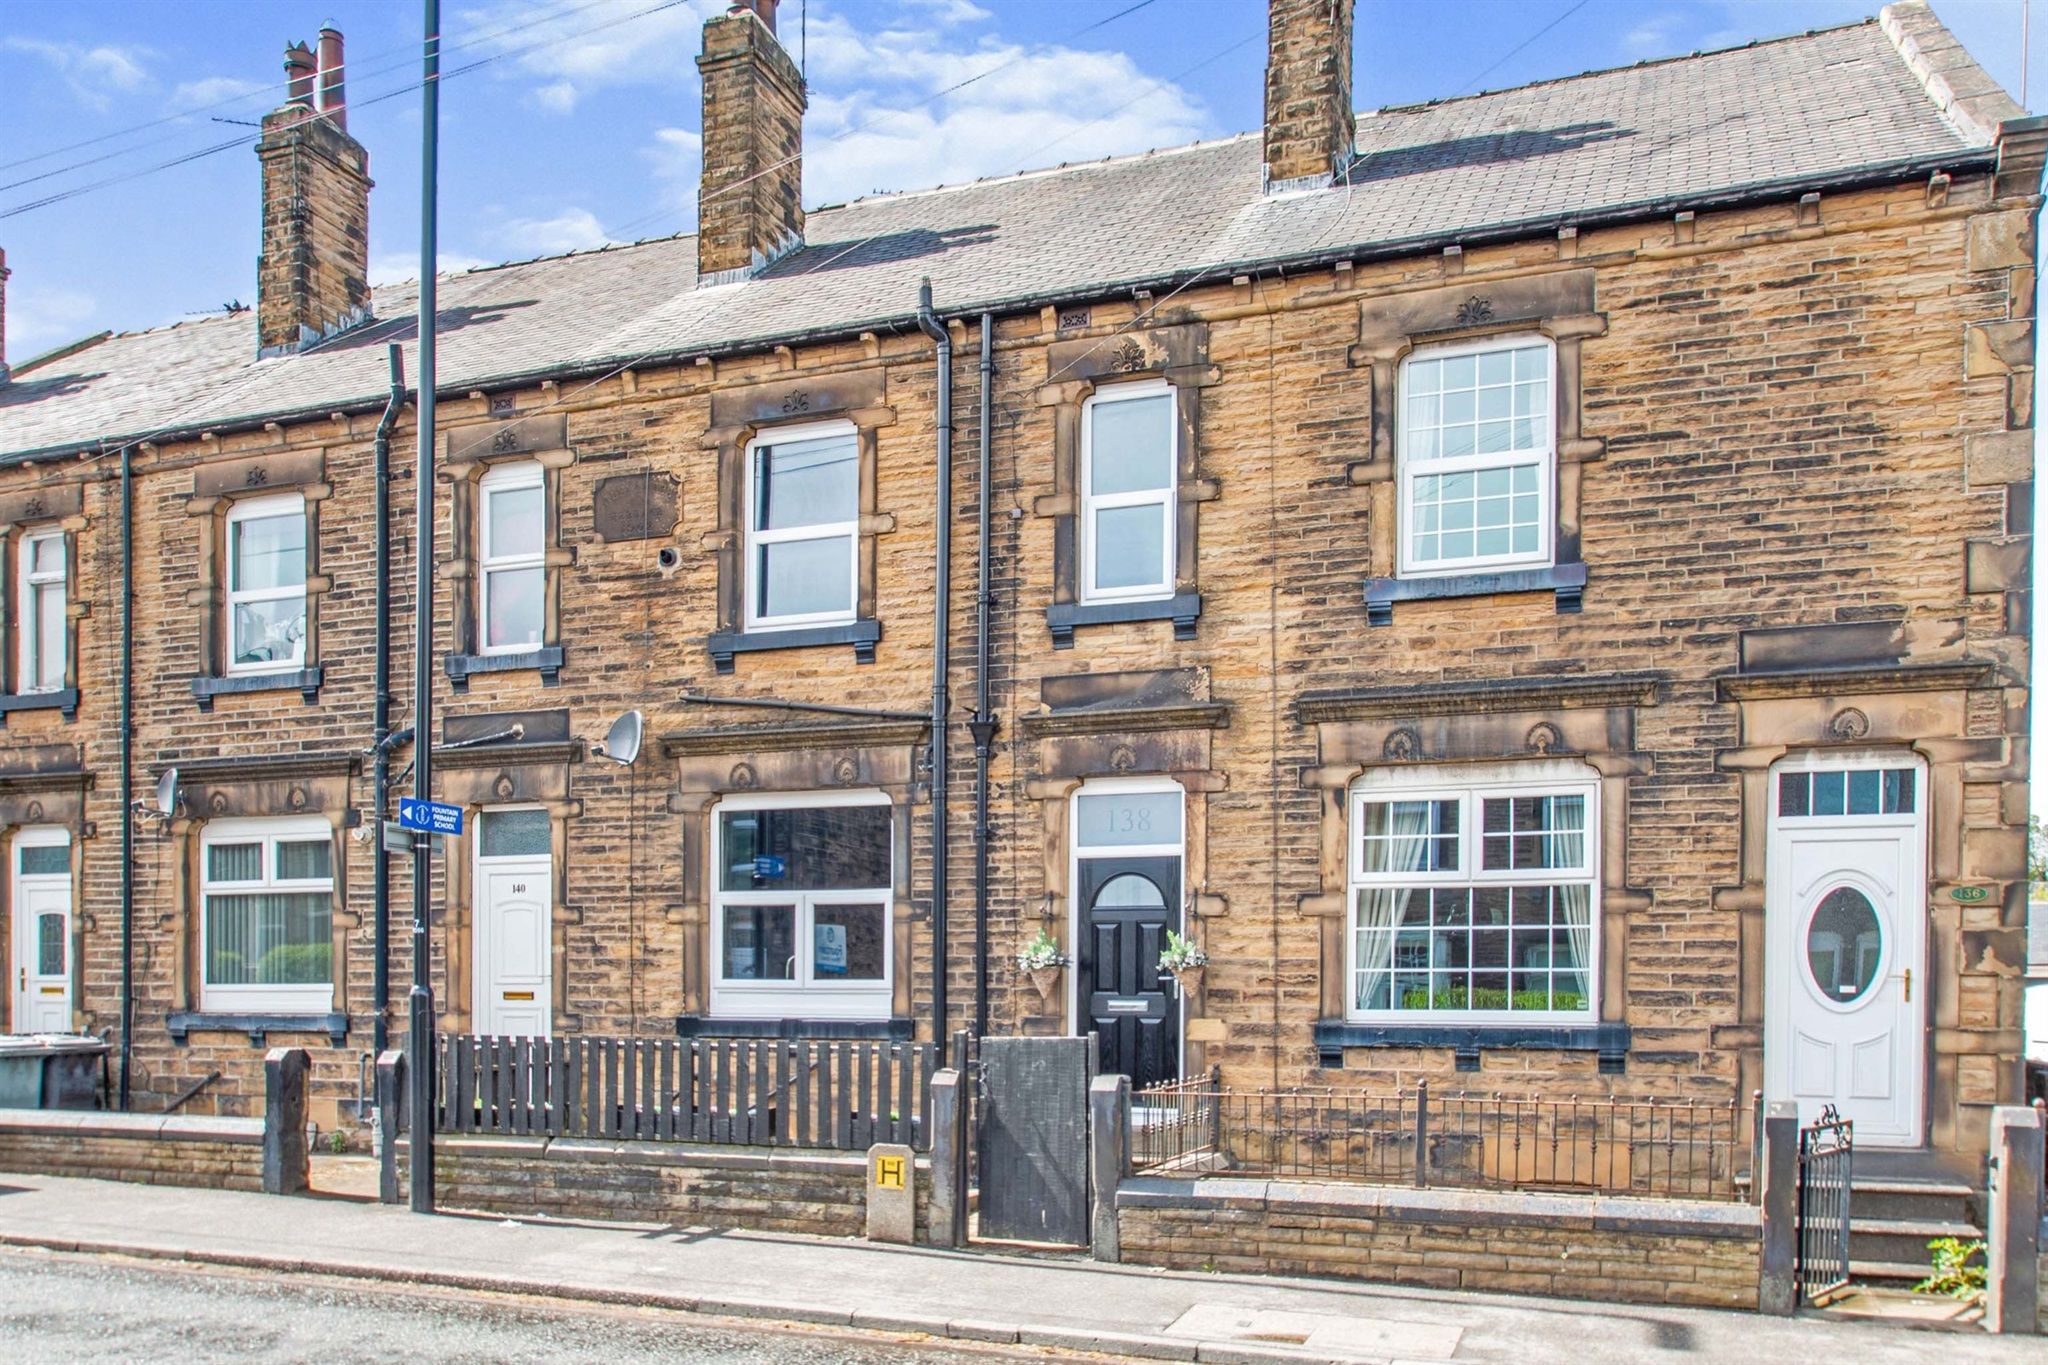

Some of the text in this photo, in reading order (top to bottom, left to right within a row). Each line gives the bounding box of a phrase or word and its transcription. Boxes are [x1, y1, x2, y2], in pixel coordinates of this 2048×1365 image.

[432, 806, 459, 817] FOUNTAIN
[433, 814, 457, 823] PRIMARY
[1107, 808, 1151, 833] 138
[434, 821, 455, 831] SCHOOL
[512, 884, 526, 894] 140
[882, 1159, 900, 1186] H
